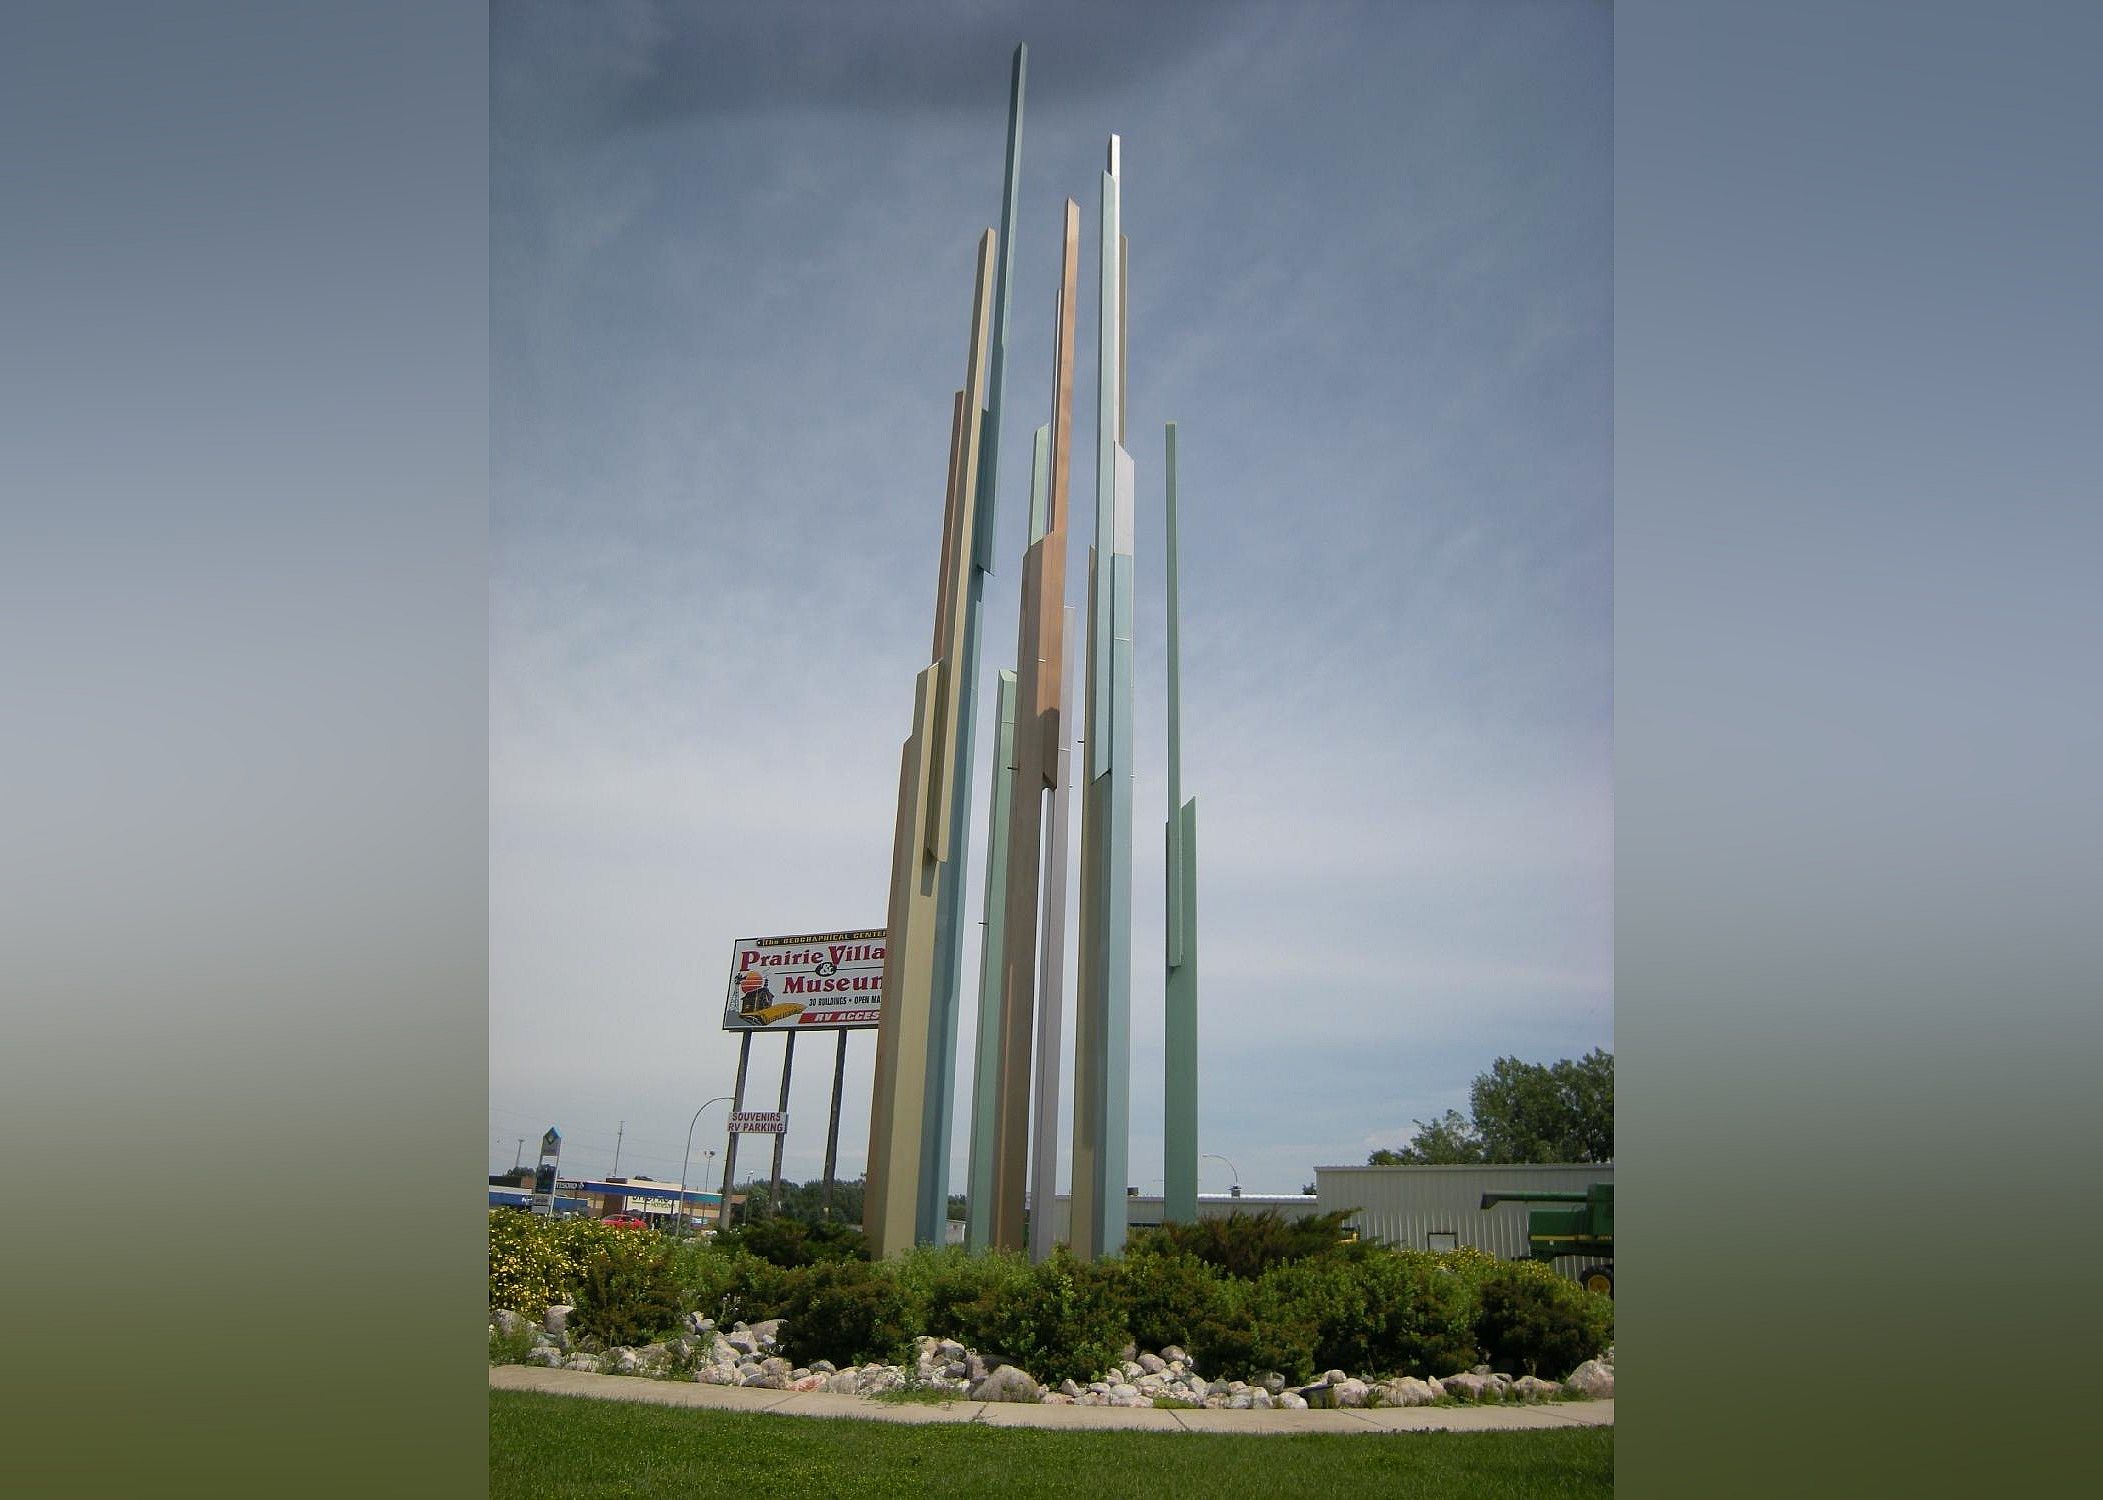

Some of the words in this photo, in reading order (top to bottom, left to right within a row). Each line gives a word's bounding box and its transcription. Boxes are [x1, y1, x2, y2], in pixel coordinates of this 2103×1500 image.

[783, 933, 850, 945] GEOGRAPHICAL
[739, 949, 824, 972] Prairie
[819, 962, 836, 977] &
[808, 998, 817, 1007] 30
[818, 996, 847, 1007] BUILDINGS
[854, 995, 870, 1005] OPEN
[814, 1012, 833, 1022] RV
[837, 1011, 881, 1021] ACCES
[732, 1112, 781, 1121] SOUVENIRS
[728, 1122, 741, 1132] RV
[743, 1122, 784, 1132] PARKING
